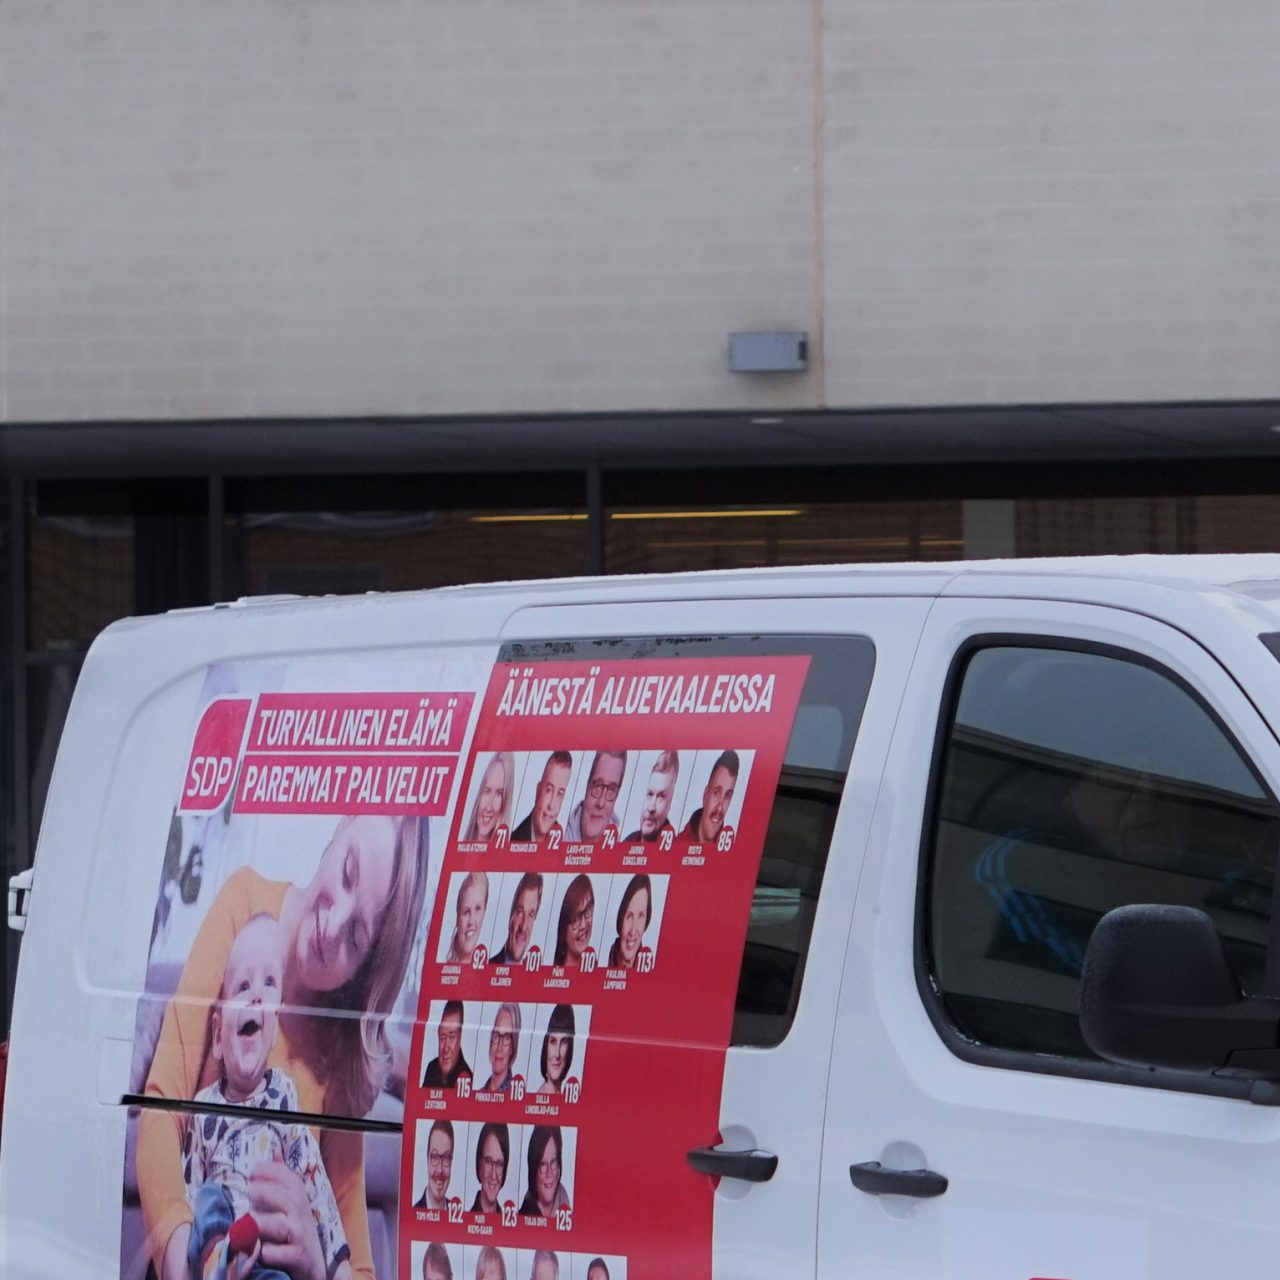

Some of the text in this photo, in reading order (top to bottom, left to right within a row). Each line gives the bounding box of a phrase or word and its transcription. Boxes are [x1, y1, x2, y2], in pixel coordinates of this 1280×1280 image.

[496, 666, 776, 716] ÄÄNESTÄ ALUEVAALEISSA
[256, 698, 458, 746] TURVALLINEN ELÄMÄ
[187, 756, 233, 798] SDP
[241, 766, 450, 804] PAREMMAT PALVELUT
[495, 829, 507, 849] 71
[547, 830, 561, 850] 72
[601, 829, 615, 850] 74
[659, 830, 674, 851] 79
[717, 830, 733, 852] 85
[472, 949, 487, 970] 92
[525, 951, 540, 973] 101
[580, 951, 595, 973] 110
[636, 951, 652, 973] 113
[457, 1077, 471, 1098] 115
[510, 1080, 524, 1101] 116
[564, 1082, 579, 1104] 118
[448, 1202, 463, 1224] 122
[501, 1206, 517, 1228] 123
[555, 1209, 572, 1231] 125
